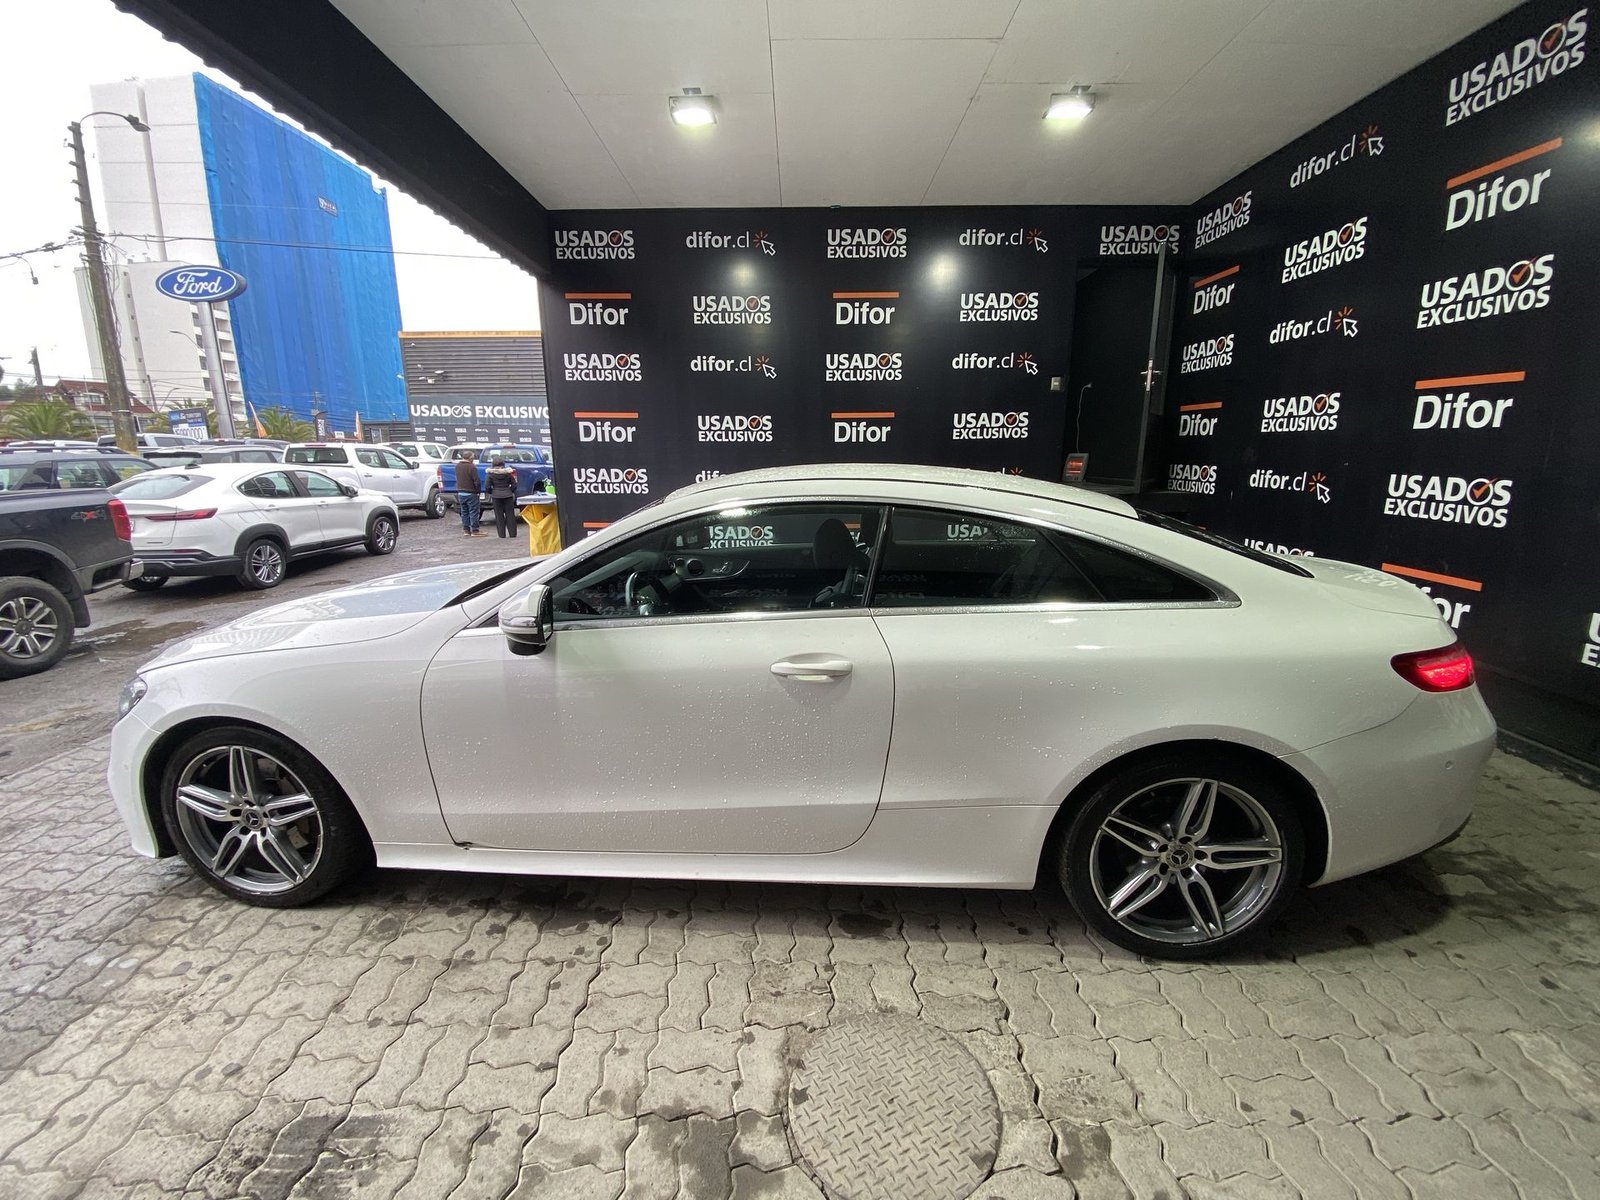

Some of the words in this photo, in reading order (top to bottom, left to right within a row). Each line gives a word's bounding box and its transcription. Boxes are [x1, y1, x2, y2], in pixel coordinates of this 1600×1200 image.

[1448, 8, 1588, 103] USADOS
[1445, 41, 1587, 127] EXCLUSIVOS
[1290, 134, 1357, 188] difor.cl
[1445, 169, 1551, 231] Difor
[1196, 191, 1253, 235] USADOS
[555, 230, 634, 247] USADOS
[827, 228, 907, 245] USADOS
[959, 229, 1023, 246] difor.cl
[1101, 225, 1180, 242] USADOS
[1195, 210, 1250, 250] EXCLUSIVOS
[686, 231, 750, 248] difor.cl
[1100, 242, 1179, 255] EXCLUSIVS
[1284, 216, 1368, 266] USADOS
[556, 247, 635, 260] EXCLUSIVOS
[827, 245, 907, 259] EXCLUSIVOS
[1282, 241, 1365, 284] EXCLUSIVOS
[173, 271, 222, 294] Ford
[1421, 254, 1554, 308] USADOS
[693, 296, 771, 313] USADOS
[960, 292, 1038, 309] USADOS
[1193, 282, 1235, 315] Difor
[1417, 285, 1551, 329] EXCLUSIVOS
[569, 303, 628, 325] Difor
[693, 312, 771, 325] EXCLUSIVOS
[836, 303, 895, 325] Difor
[960, 309, 1038, 322] EXCLUSIVOS
[1269, 310, 1332, 344] difor.cl
[1183, 334, 1234, 362] USADOS
[564, 354, 640, 369] USADOS
[691, 356, 751, 372] difor.cl
[825, 353, 902, 369] USADOS
[952, 352, 1014, 369] difor.cl
[1181, 352, 1232, 374] EXCLUSIVOS
[565, 369, 642, 381] EXCLUSIVOS
[825, 369, 902, 382] EXCLUSIVOS
[410, 405, 472, 418] USADOS
[1263, 392, 1341, 417] USADOS
[1413, 393, 1513, 430] Difor
[697, 415, 772, 430] USADOS
[953, 412, 1029, 427] USADOS
[1179, 413, 1217, 437] Difor
[1261, 414, 1338, 433] EXCLUSIVOS
[579, 421, 636, 442] Difor
[698, 430, 773, 442] EXCLUSIVOS
[834, 422, 890, 443] Difor
[952, 427, 1028, 440] EXCLUSIVOS
[573, 469, 648, 483] USADOS
[1169, 464, 1217, 482] USADOS
[1249, 469, 1306, 492] difor.cl
[574, 482, 649, 494] EXCLUSIVOS
[1167, 480, 1215, 495] EXCLUSIVOS
[1388, 474, 1513, 507] USADOS
[1384, 499, 1507, 528] EXCLUSIVOS
